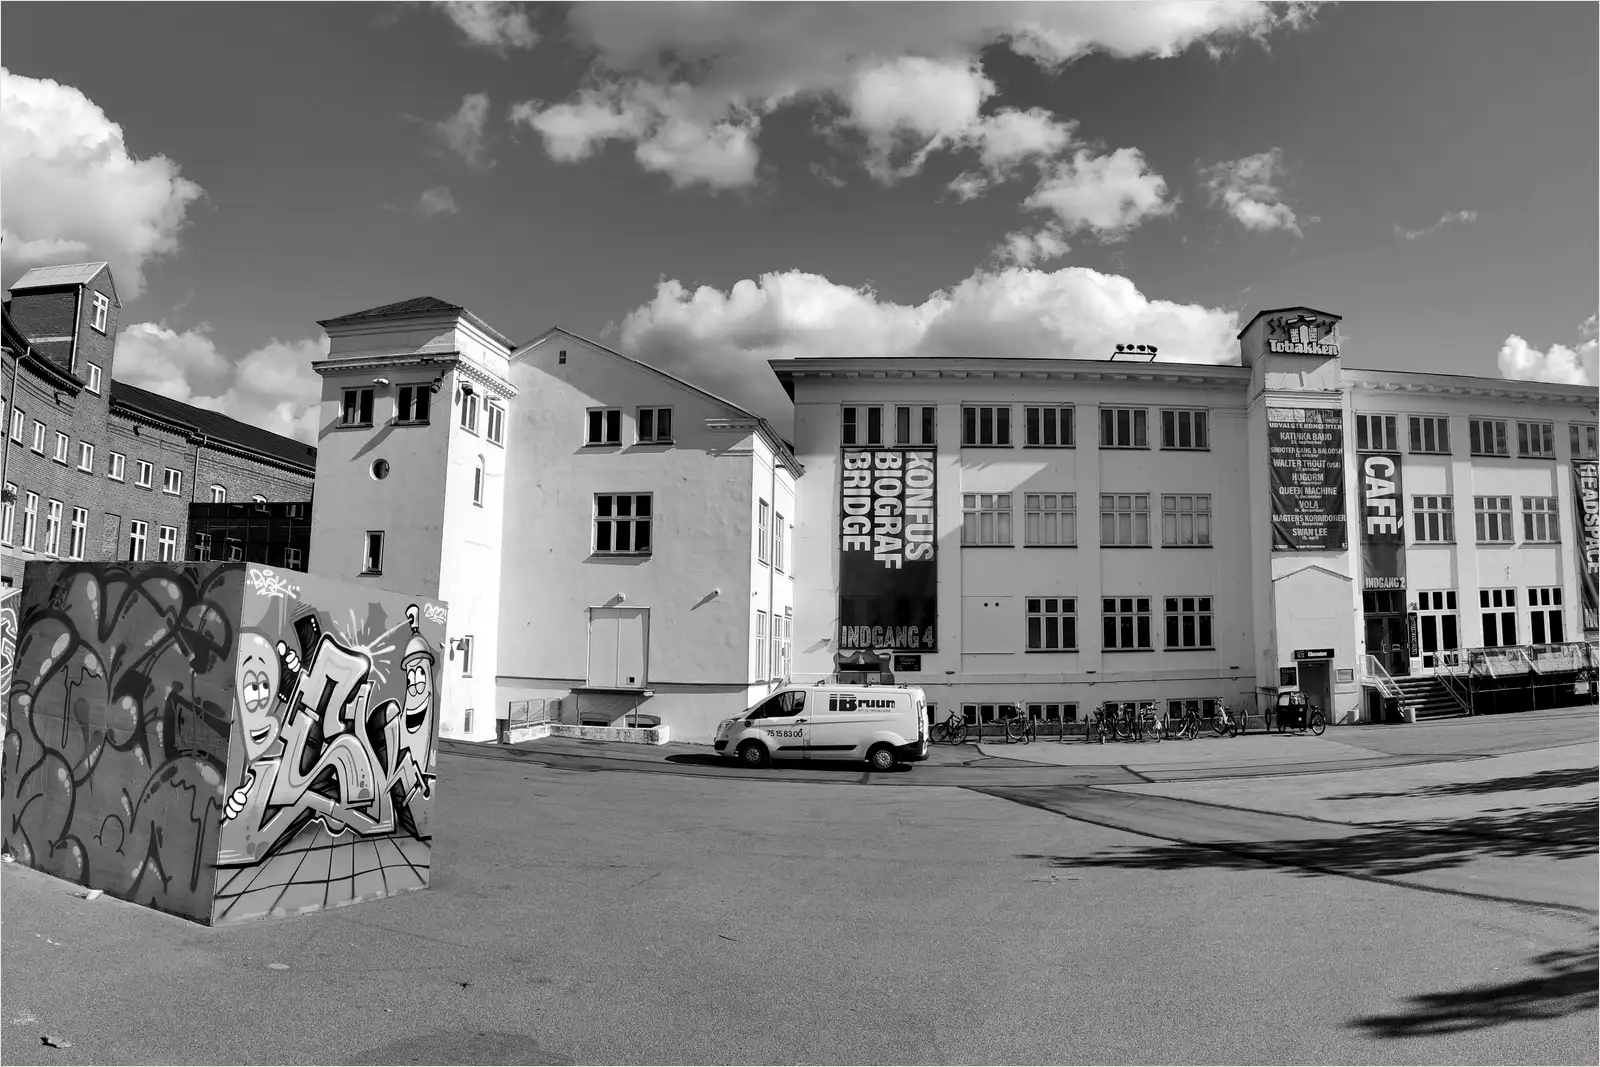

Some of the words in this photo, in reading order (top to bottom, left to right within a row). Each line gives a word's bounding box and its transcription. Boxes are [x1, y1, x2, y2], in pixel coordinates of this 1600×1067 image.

[1268, 339, 1339, 355] Tobakken
[1280, 432, 1311, 441] KATINKA
[1312, 433, 1332, 441] BAND
[1273, 459, 1302, 467] WALTER
[1302, 459, 1326, 468] TROUT
[1292, 473, 1324, 481] HUGORM
[1279, 486, 1303, 495] QUEEN
[1304, 487, 1337, 495] MACHINE
[842, 452, 871, 551] BRIDGE
[905, 452, 934, 561] KONFUS
[1299, 500, 1319, 509] VOLA
[874, 452, 902, 569] BIOGRAF
[1272, 514, 1304, 522] MAGTENS
[1305, 514, 1346, 522] KORRIDORER
[1580, 464, 1599, 574] HEADSPACE
[1292, 528, 1314, 536] SWAN
[1314, 528, 1328, 536] LEE
[1365, 577, 1398, 589] INDGANG
[1399, 576, 1406, 588] 2
[841, 625, 920, 648] INDGANG
[922, 626, 934, 648] 4
